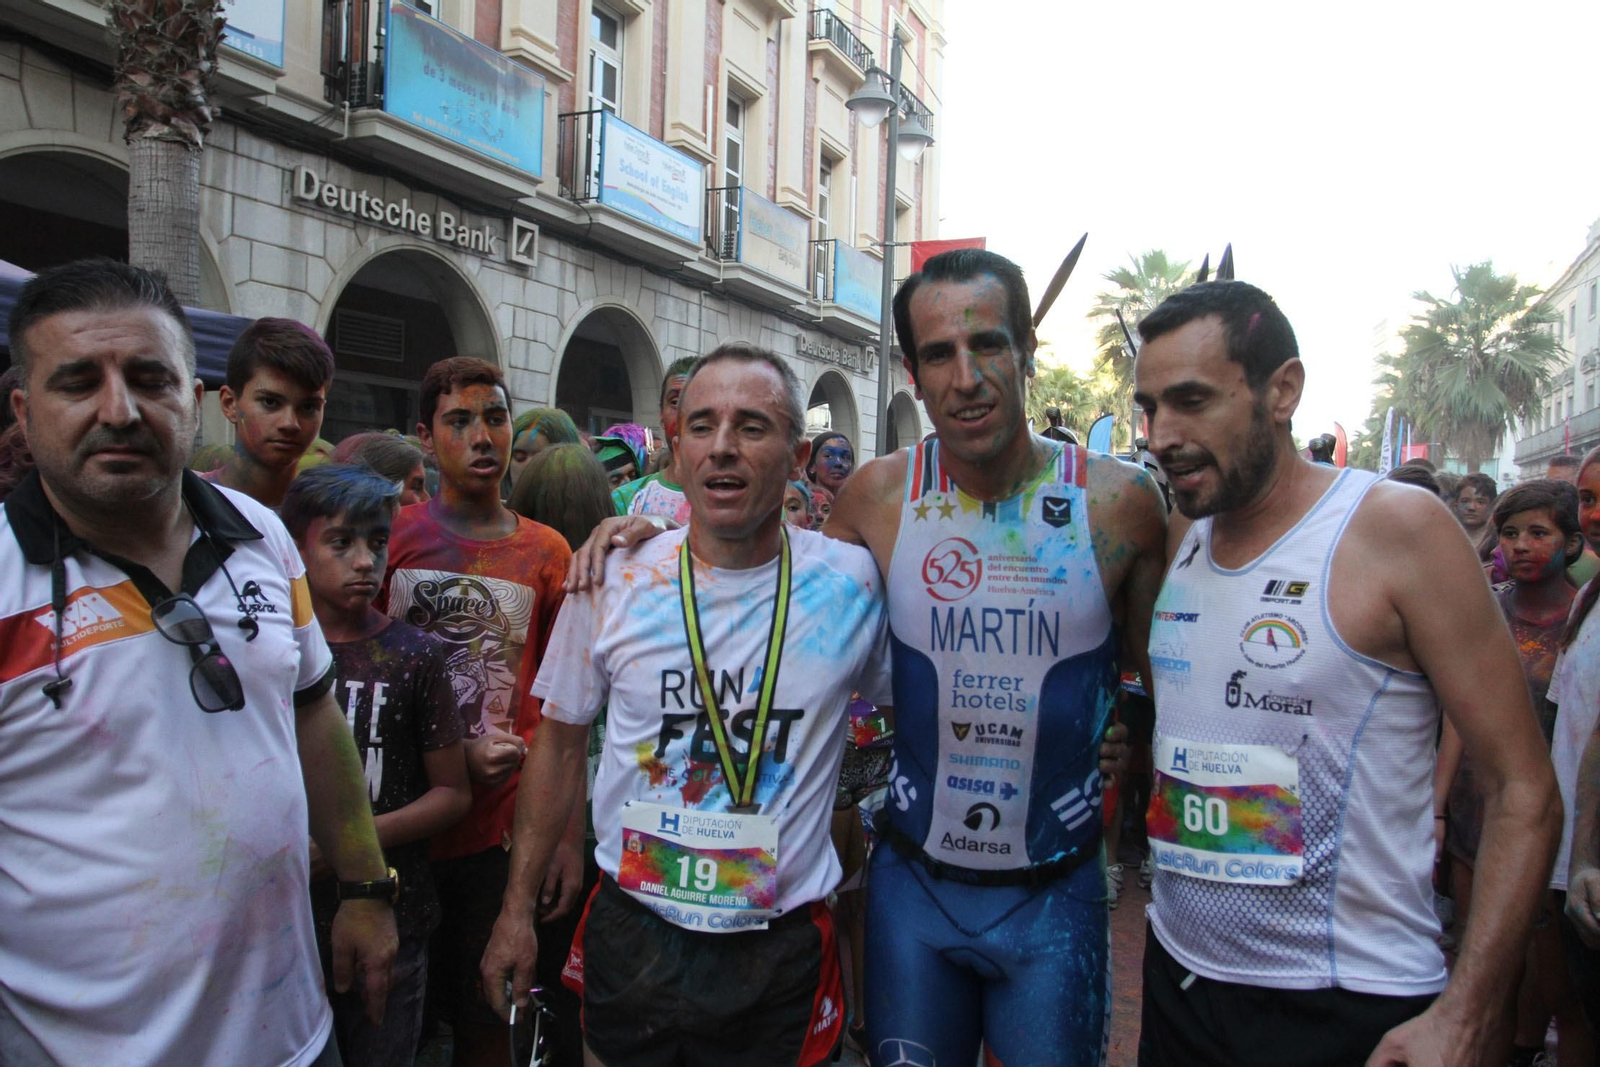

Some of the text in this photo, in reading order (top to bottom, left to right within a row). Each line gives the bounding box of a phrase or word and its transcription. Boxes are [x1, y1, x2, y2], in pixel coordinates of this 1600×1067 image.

[618, 158, 648, 183] School
[650, 174, 659, 188] of
[662, 177, 689, 204] English
[297, 166, 498, 255] Deutsche Bank
[800, 333, 862, 369] Deutsche Bank
[987, 554, 1038, 563] aniversario
[987, 564, 1049, 574] del encuentro
[1013, 574, 1029, 583] dos
[1031, 576, 1067, 585] mundos
[987, 584, 1056, 597] Huelva-América
[1251, 612, 1283, 623] ATLETISMO
[930, 598, 1060, 658] MARTÍN
[660, 666, 745, 709] RUN
[952, 669, 1024, 692] ferrer
[951, 690, 1027, 712] hotels
[1242, 692, 1314, 716] Moral
[654, 708, 805, 765] FEST
[974, 723, 1024, 740] UCAM
[975, 736, 1021, 747] UNIVERSIDAD
[949, 753, 1021, 771] SHIMANO
[1188, 748, 1248, 763] DIPUTACIÓN
[1188, 760, 1242, 775] DE HUELVA
[946, 775, 995, 794] asisa
[682, 814, 742, 829] DIPUTACIÓN
[1183, 793, 1229, 836] 60
[682, 825, 735, 840] DE HUELVA
[940, 832, 1011, 854] Adarsa
[676, 855, 718, 892] 19
[1225, 858, 1299, 881] Colors
[640, 881, 748, 907] DANIEL AGUIRRE MORENO
[707, 912, 767, 929] Colors
